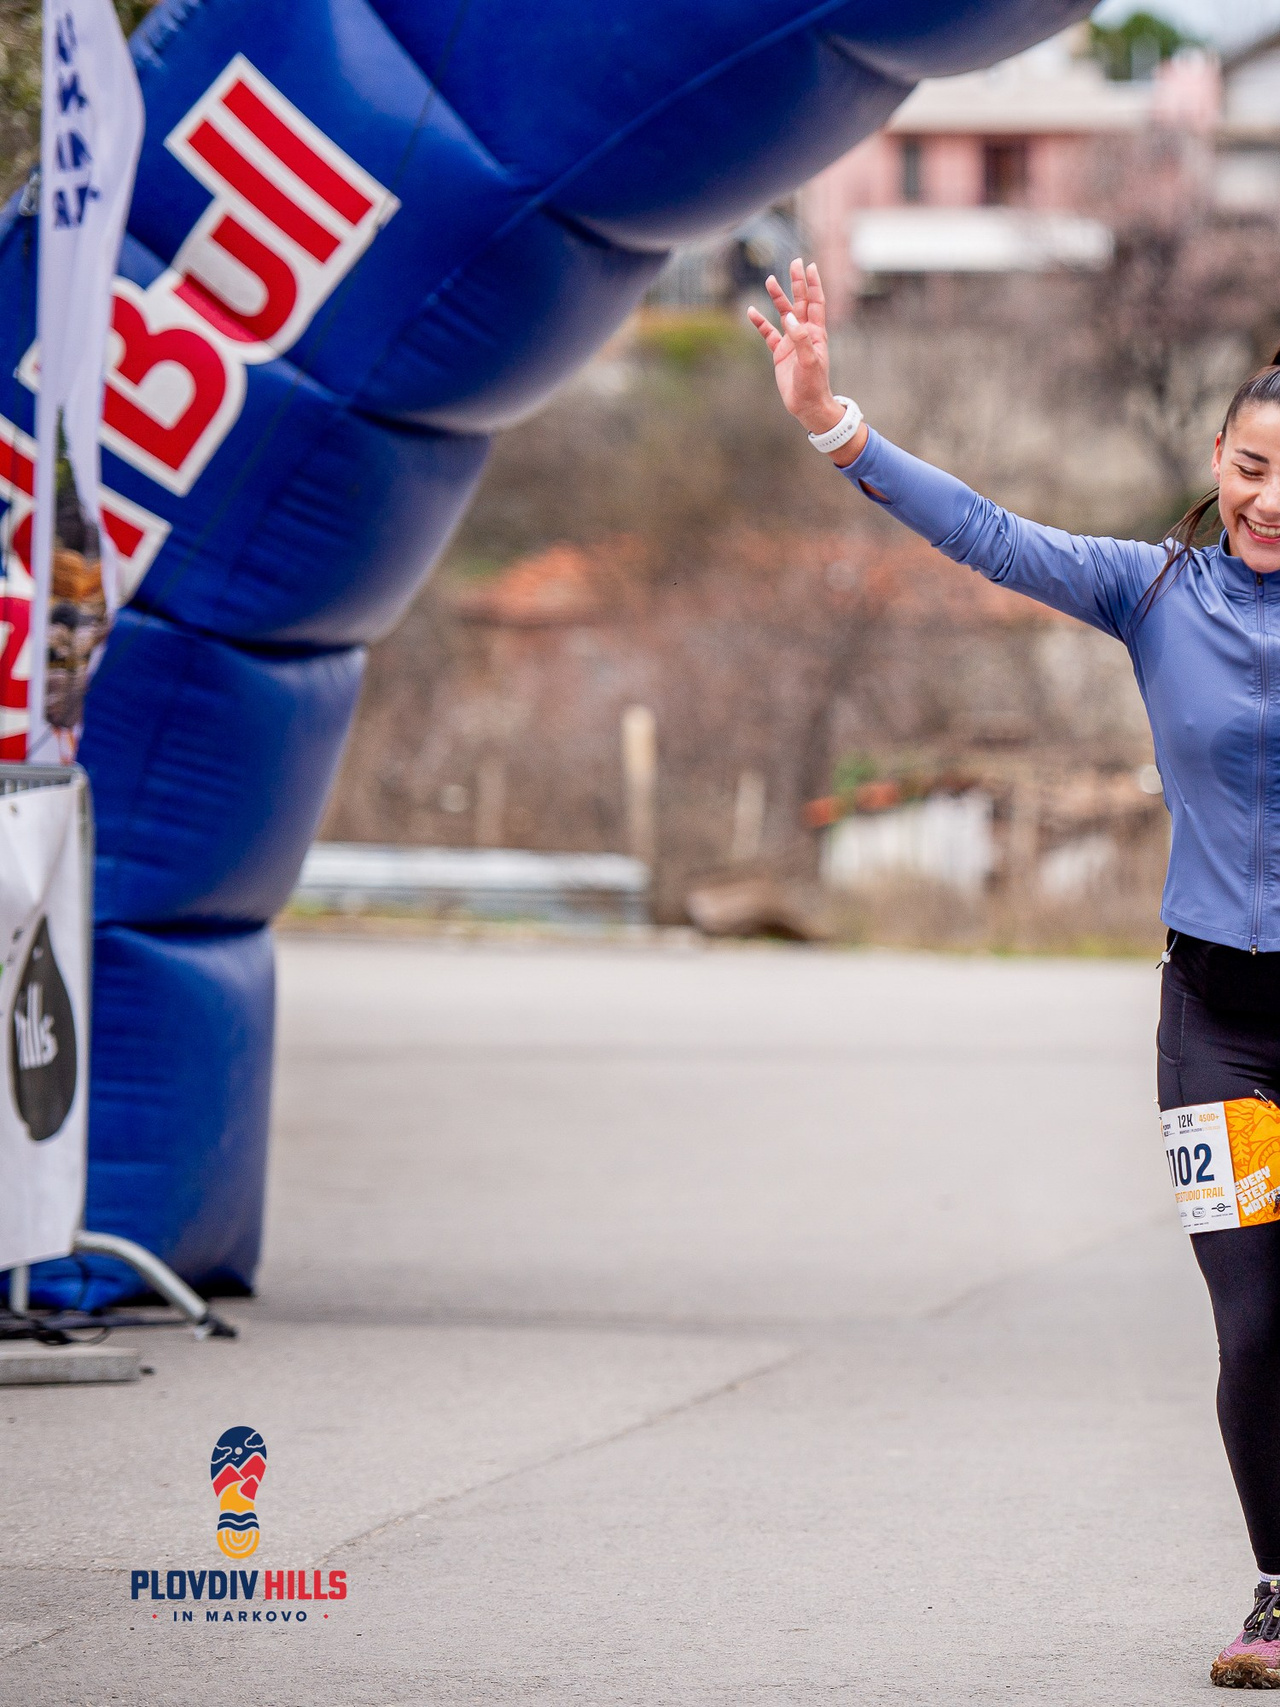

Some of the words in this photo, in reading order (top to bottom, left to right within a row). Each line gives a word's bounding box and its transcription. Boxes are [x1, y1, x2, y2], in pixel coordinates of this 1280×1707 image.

[60, 62, 392, 486] Bull
[1177, 1113, 1194, 1129] 12K
[1202, 1187, 1225, 1199] TRAIL
[1237, 1181, 1267, 1206] STEP
